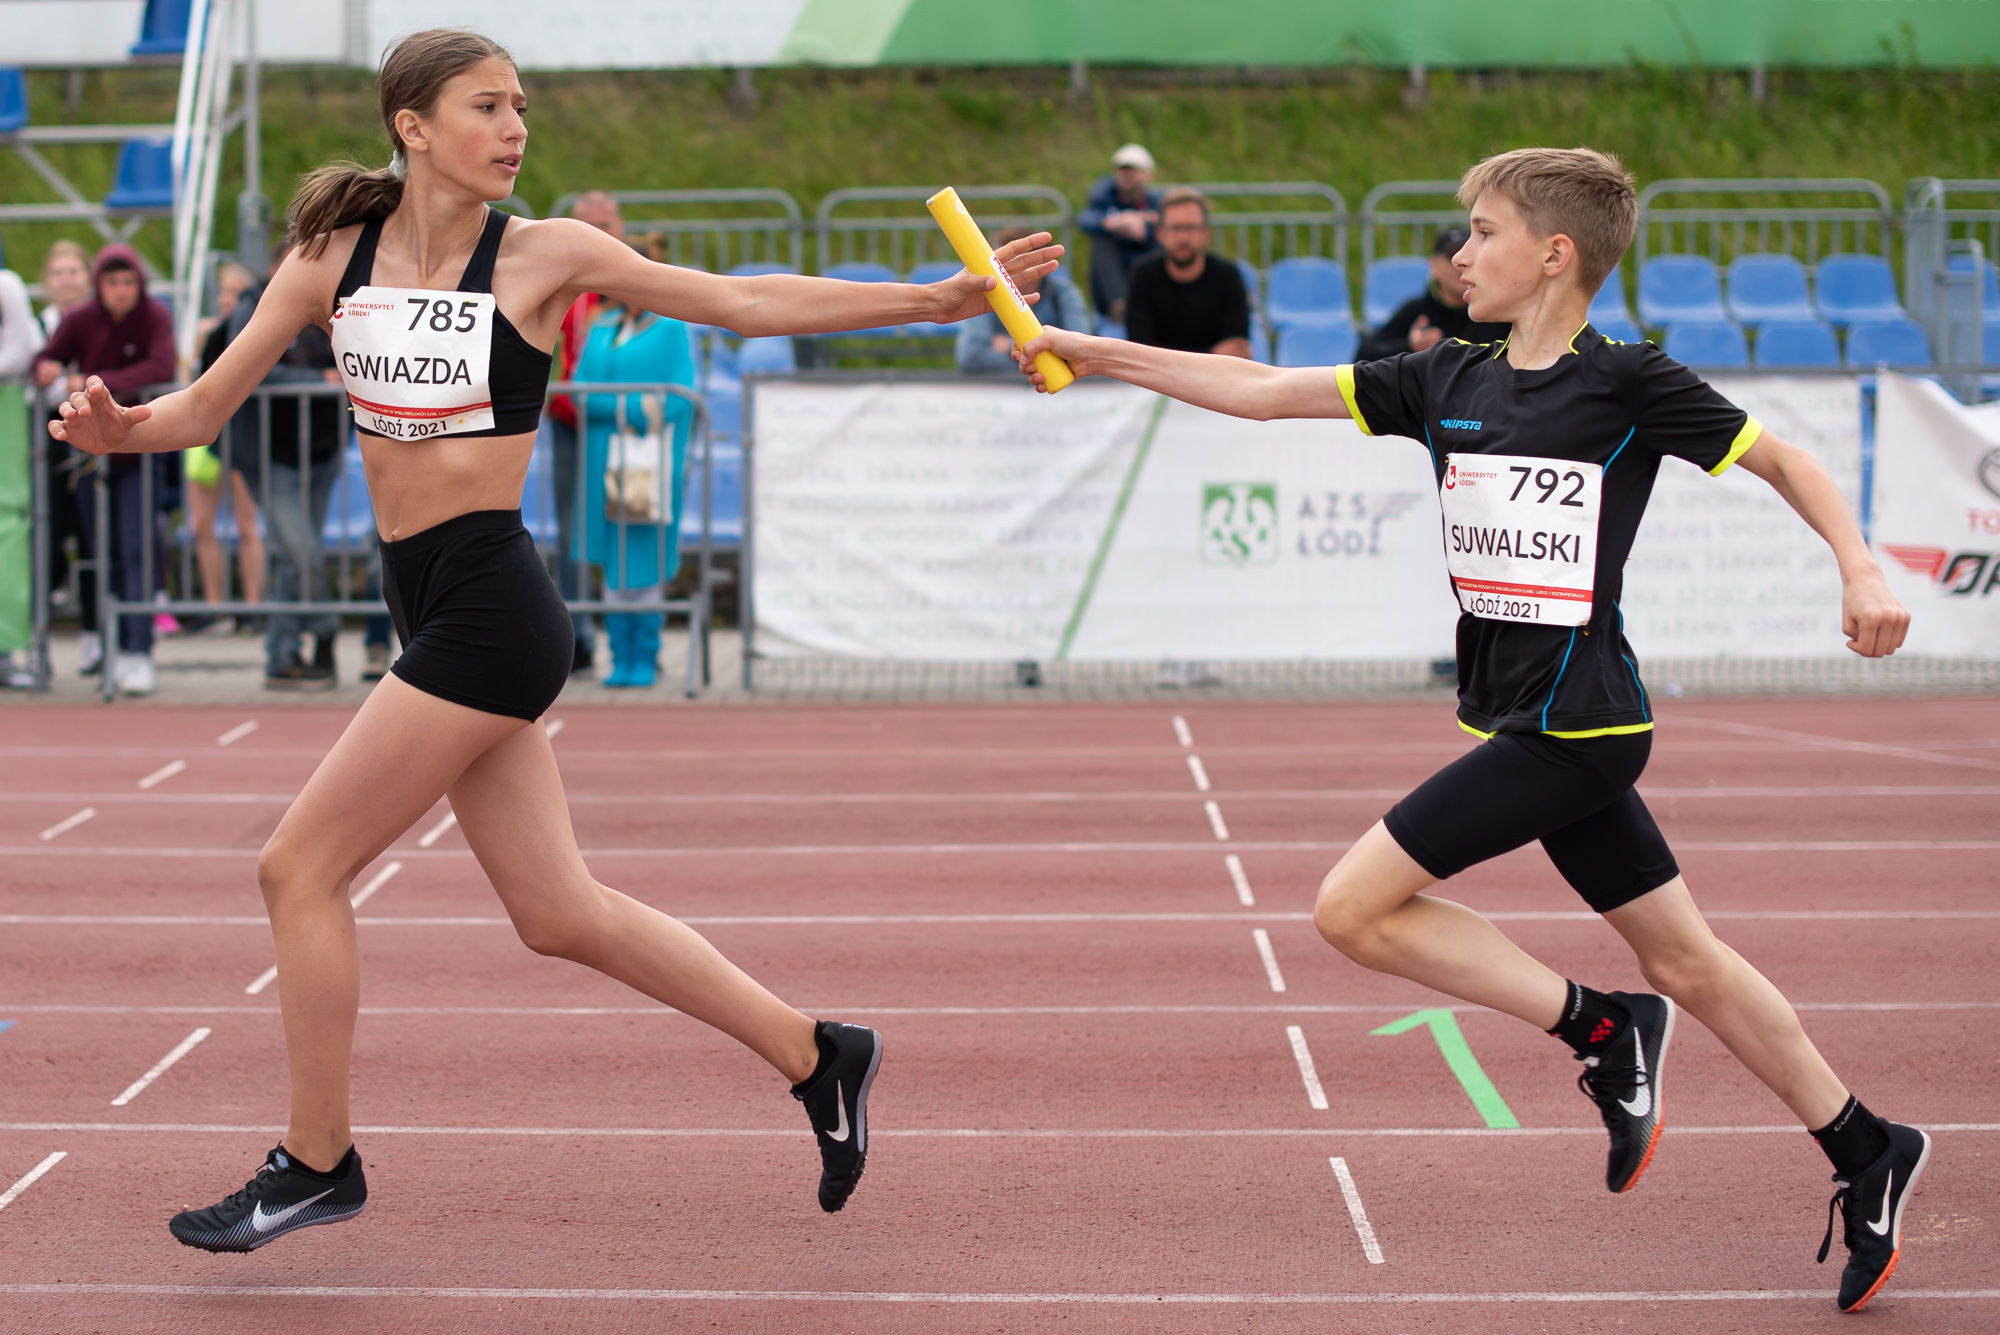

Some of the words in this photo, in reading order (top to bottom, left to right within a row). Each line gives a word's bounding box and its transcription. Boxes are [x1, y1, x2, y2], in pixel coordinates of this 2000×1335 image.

[348, 302, 395, 311] UNIWERSYTET
[408, 298, 478, 333] 785
[342, 351, 472, 386] GWIAZDA
[372, 415, 404, 437] ŁÓDŹ
[407, 420, 447, 437] 2021
[1459, 471, 1498, 479] UNIWERSYTET
[1459, 479, 1476, 487] ŁÓDZKI
[1509, 466, 1585, 508] 792
[1451, 524, 1581, 564] SUWALSKI
[1470, 593, 1501, 615] ŁÓDŹ
[1502, 600, 1540, 619] 2021
[1368, 1008, 1521, 1129] 1
